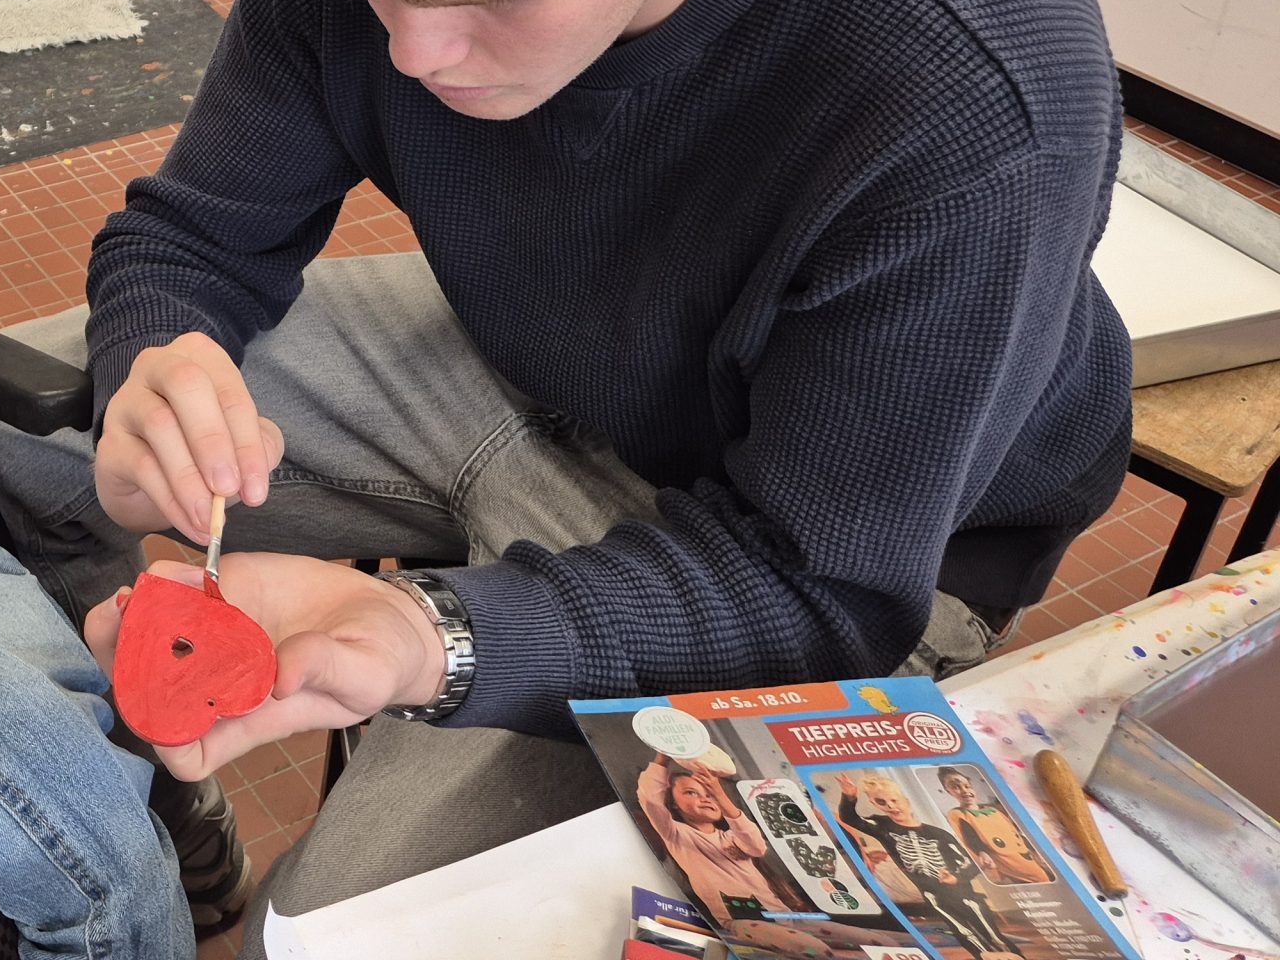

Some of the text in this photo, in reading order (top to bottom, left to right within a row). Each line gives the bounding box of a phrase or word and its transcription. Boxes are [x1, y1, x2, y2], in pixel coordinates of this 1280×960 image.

[710, 692, 808, 710] ab Sa. 18.10.
[645, 723, 694, 735] FAMILIEN
[788, 720, 903, 743] TIEFPREIS-
[913, 726, 955, 741] ALDI
[660, 735, 689, 744] WELT
[801, 739, 910, 758] HIGHLIGHTS
[654, 900, 673, 911] alle.
